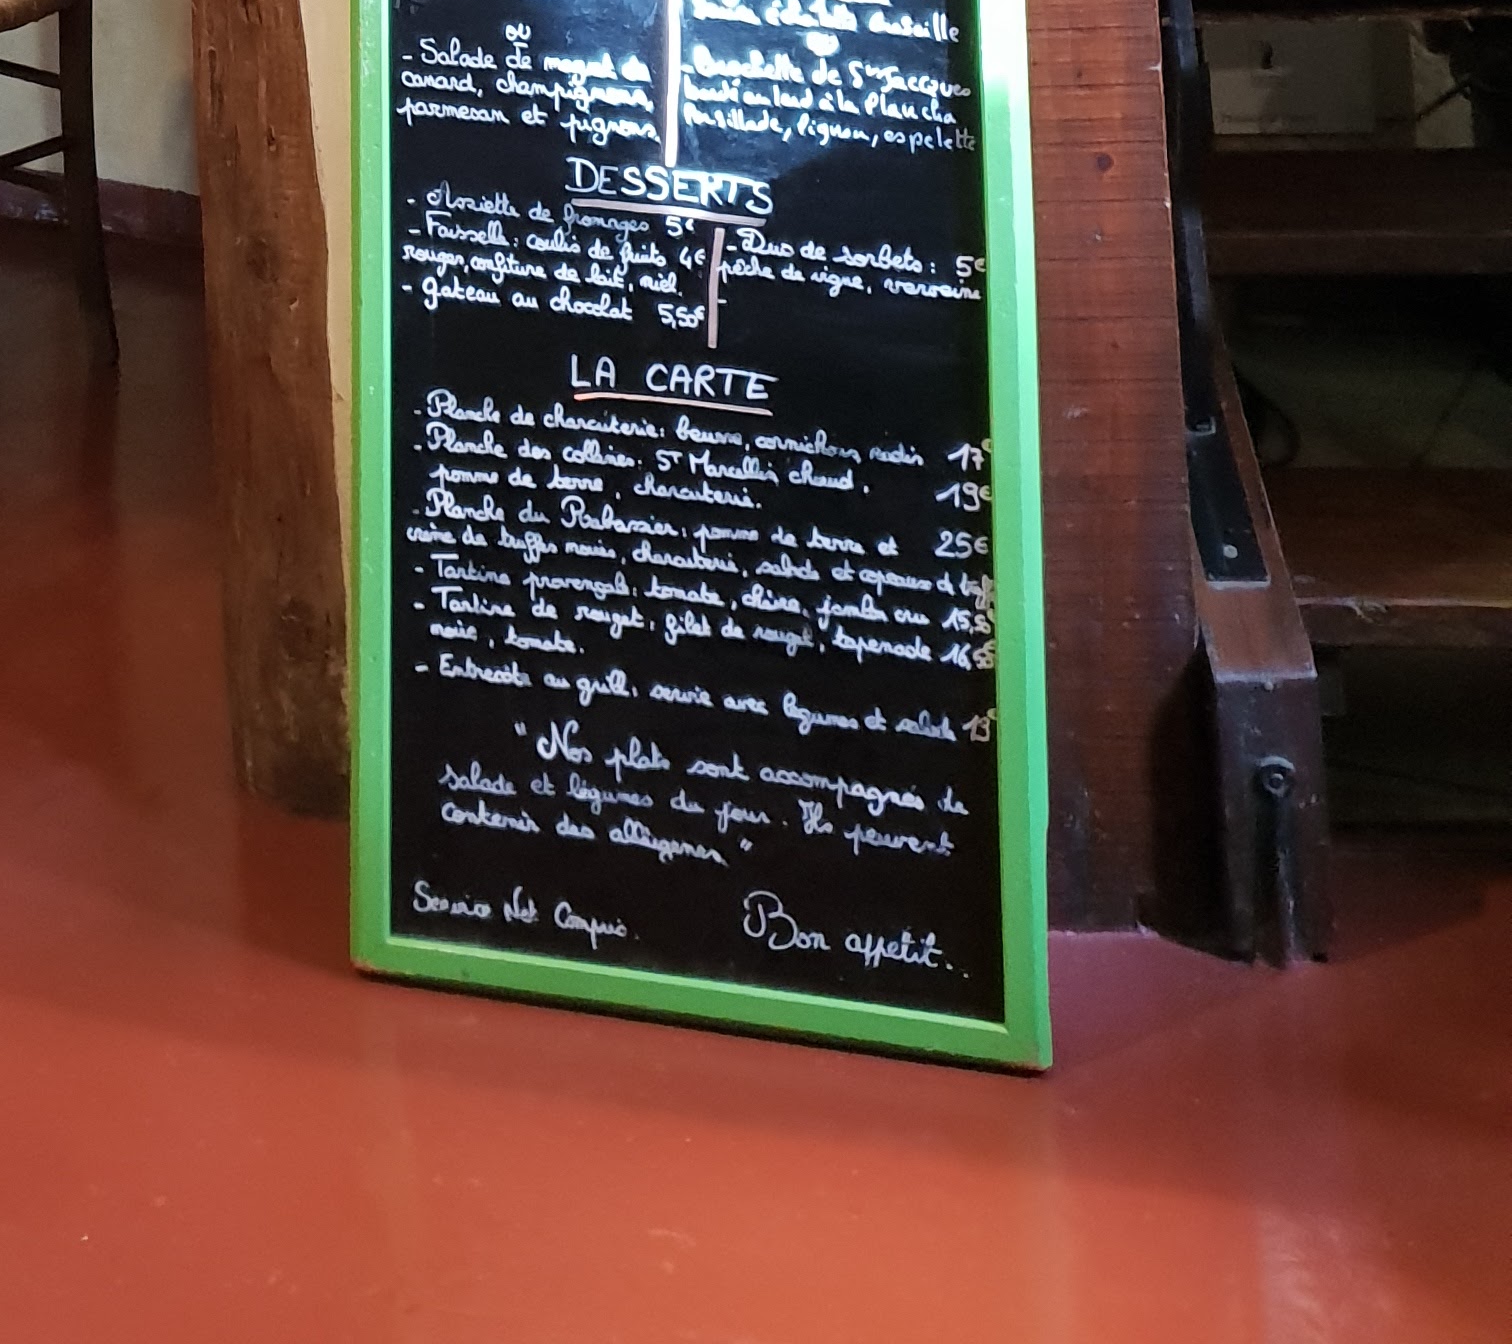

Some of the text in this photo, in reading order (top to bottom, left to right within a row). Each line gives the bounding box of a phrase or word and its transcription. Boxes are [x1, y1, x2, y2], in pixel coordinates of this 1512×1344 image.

[419, 37, 498, 71] Salade
[812, 57, 842, 86] de
[401, 70, 484, 99] canard,
[397, 96, 510, 127] parmesan
[521, 104, 548, 126] et
[564, 155, 774, 215] DESSERTS
[527, 201, 555, 223] de
[526, 226, 581, 255] coulis
[587, 238, 614, 261] de
[736, 227, 796, 258] Duo
[799, 240, 827, 262] de
[553, 262, 581, 284] de
[781, 263, 806, 283] de
[511, 292, 539, 309] au
[549, 286, 633, 321] chocolat
[570, 353, 780, 401] LA CARTE
[426, 388, 501, 425] Planche
[509, 403, 536, 427] de
[425, 421, 508, 459] Planche
[517, 437, 552, 461] des
[507, 466, 537, 489] de
[425, 487, 505, 523] Planche
[517, 499, 551, 524] du
[771, 525, 799, 549] de
[877, 534, 899, 557] et
[461, 524, 489, 548] de
[831, 558, 857, 582] et
[430, 553, 512, 587] Tartine
[893, 607, 931, 626] cru
[430, 585, 516, 618] Tartine
[531, 596, 558, 620] de
[664, 609, 713, 646] filet
[720, 615, 747, 641] de
[543, 673, 571, 689] au
[863, 706, 888, 732] et
[604, 735, 671, 784] plats
[529, 772, 556, 797] et
[669, 788, 706, 814] du
[555, 811, 597, 840] des
[743, 889, 831, 952] Bon
